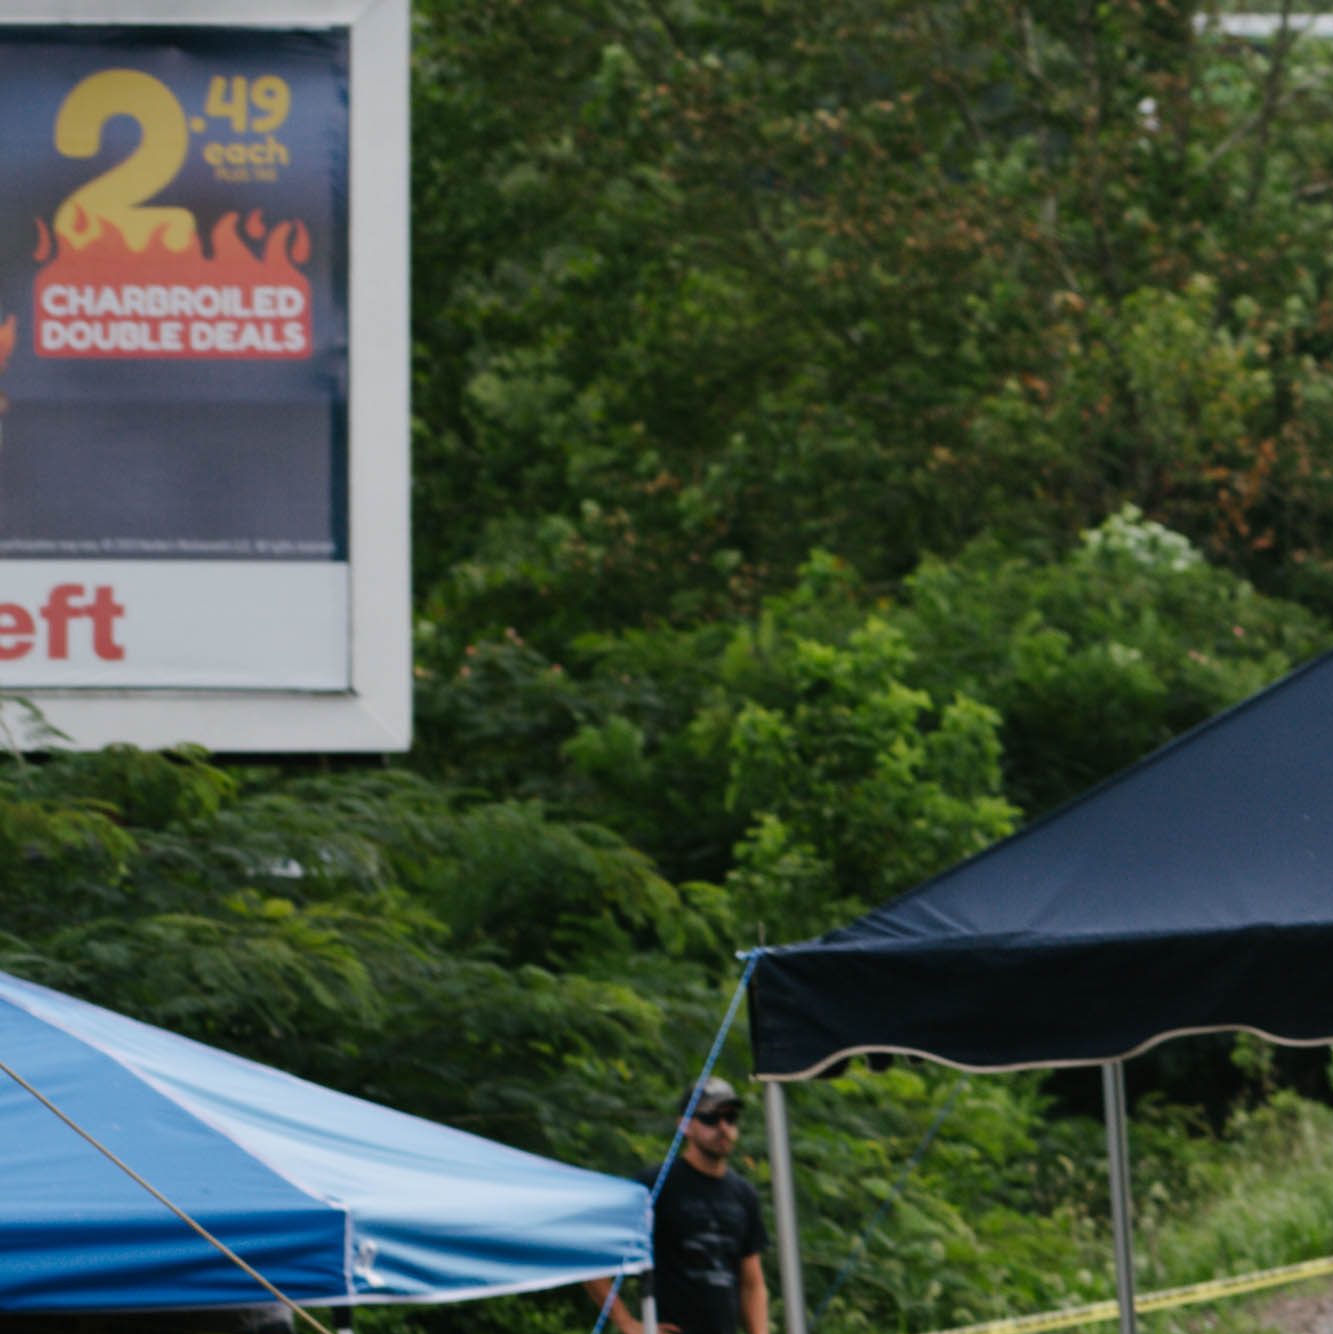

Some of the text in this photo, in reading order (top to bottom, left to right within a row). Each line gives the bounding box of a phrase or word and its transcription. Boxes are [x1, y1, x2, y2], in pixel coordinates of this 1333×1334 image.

[203, 135, 291, 166] each
[41, 283, 305, 318] CHARBROILED
[40, 320, 306, 352] DOUBLE DEALS
